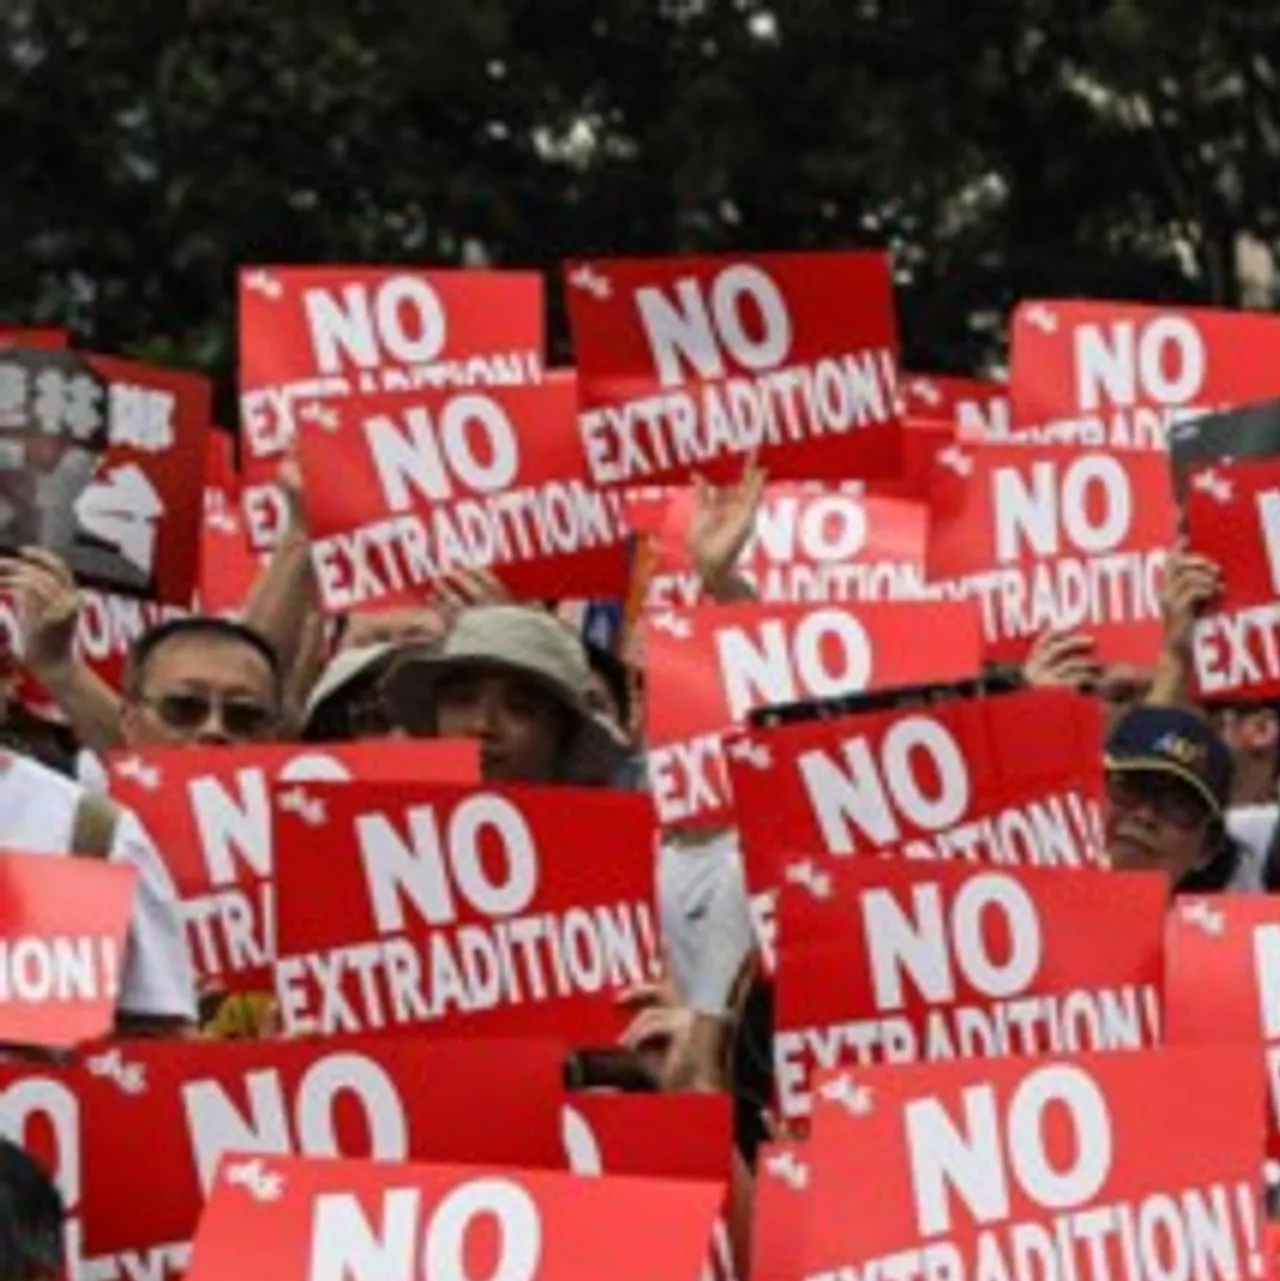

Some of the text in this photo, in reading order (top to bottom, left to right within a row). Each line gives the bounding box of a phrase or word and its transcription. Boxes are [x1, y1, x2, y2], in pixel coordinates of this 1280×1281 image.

[304, 273, 446, 373] NO
[634, 263, 793, 386] NO
[1072, 317, 1205, 410] NO
[363, 394, 519, 512] NO
[579, 349, 904, 484] EXTRADITION!
[311, 479, 628, 612] EXTRADITION!
[992, 453, 1131, 563] NO
[714, 607, 873, 722] NO
[187, 755, 353, 886] N
[797, 716, 971, 855] NO
[355, 793, 539, 934] NO
[275, 903, 664, 1036] EXTRADITION!
[860, 873, 1041, 1010] NO
[181, 1051, 410, 1199] NO
[903, 1062, 1115, 1239] NO
